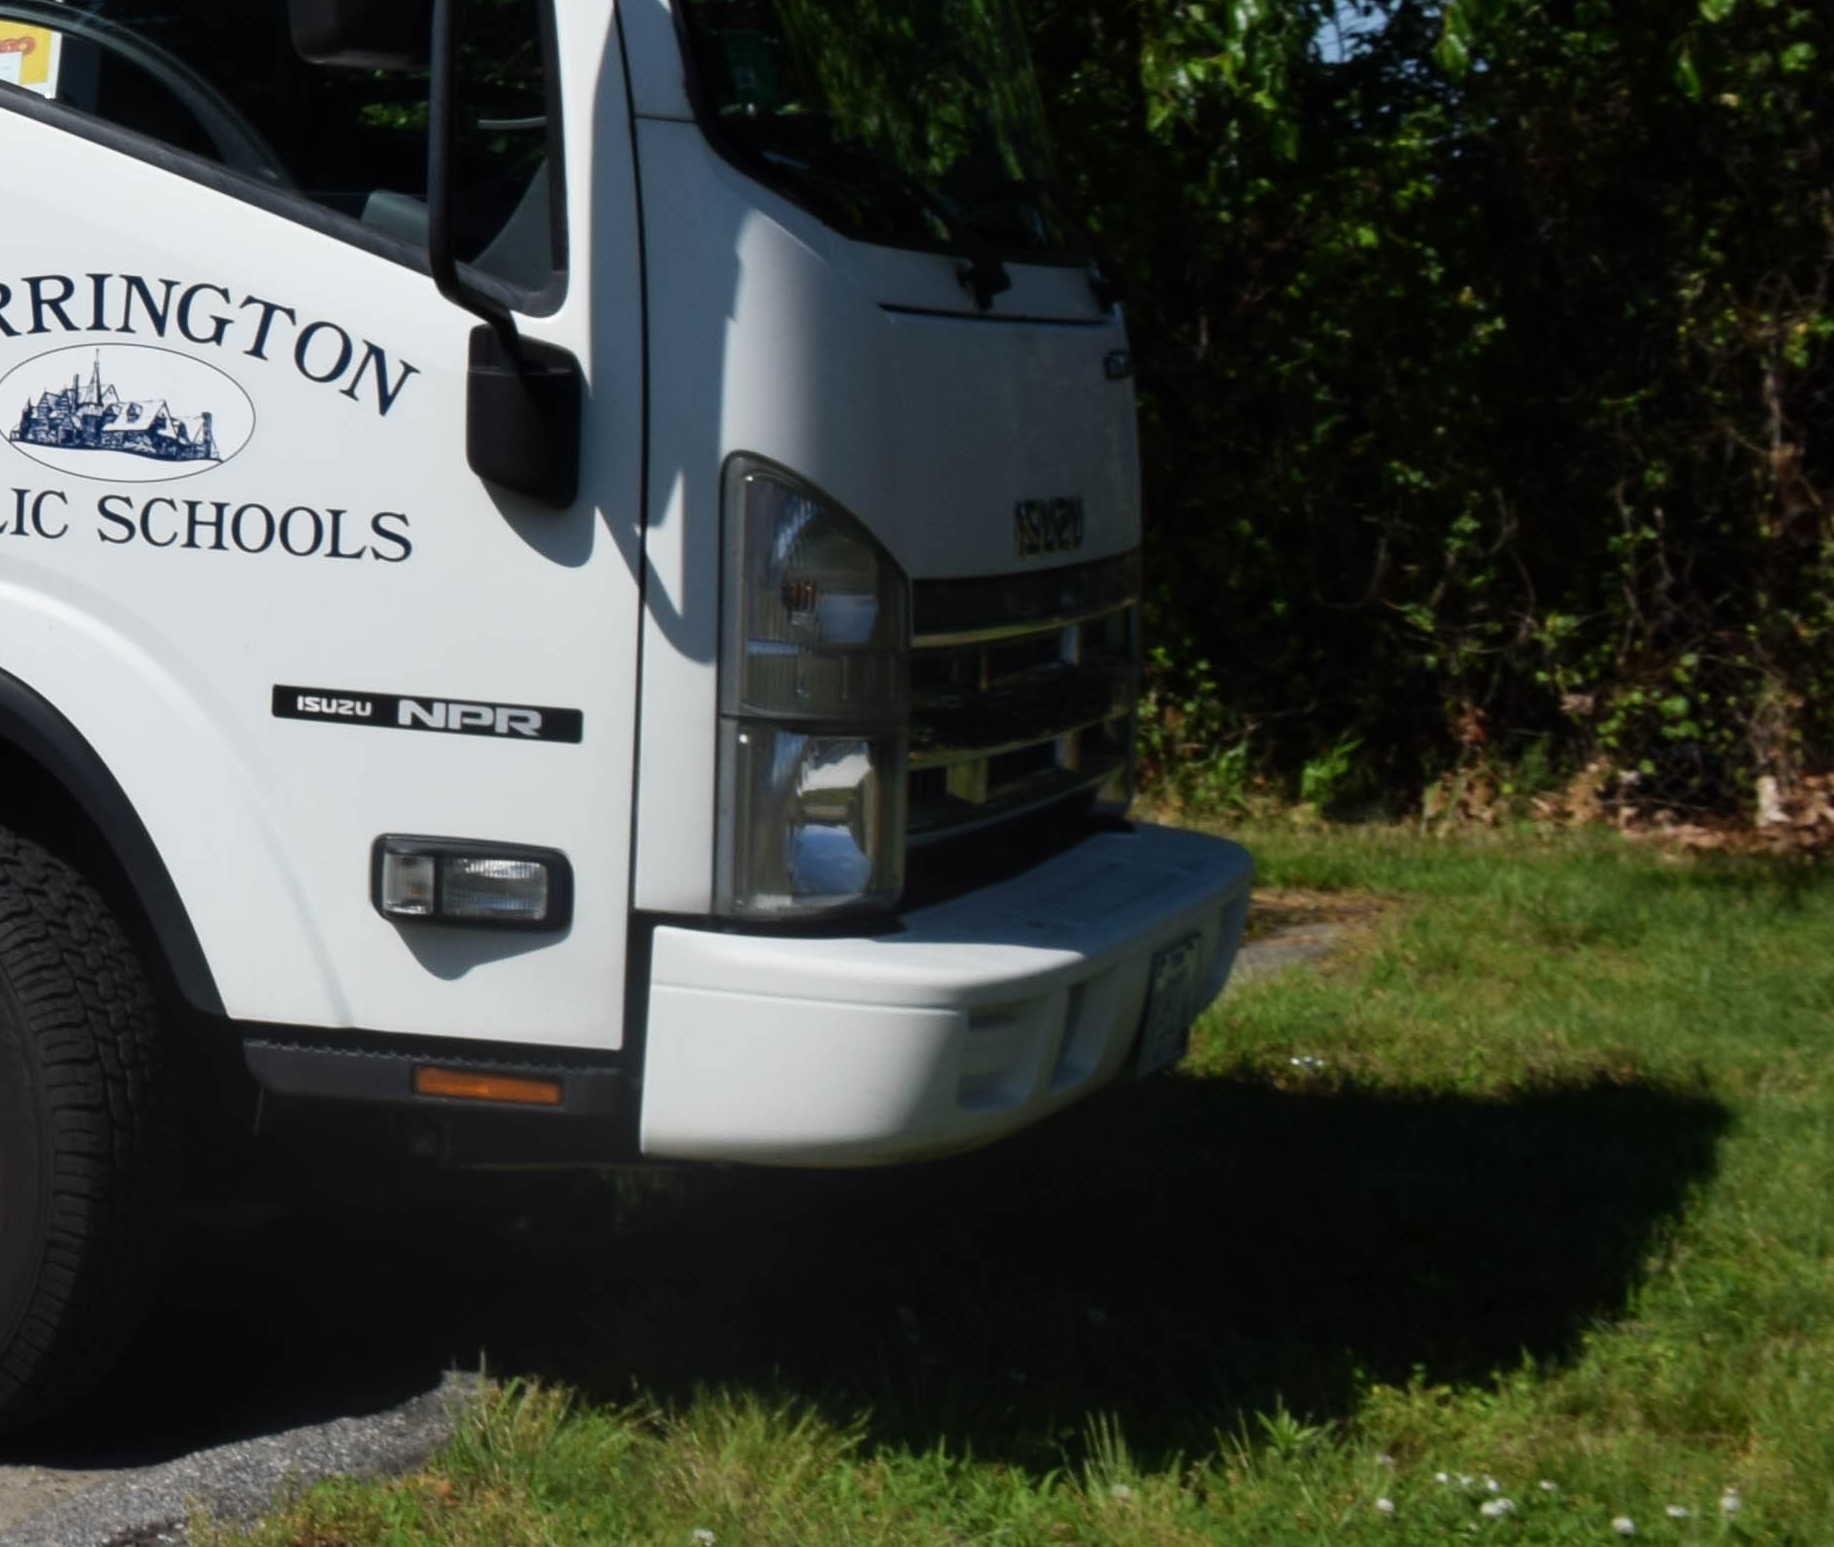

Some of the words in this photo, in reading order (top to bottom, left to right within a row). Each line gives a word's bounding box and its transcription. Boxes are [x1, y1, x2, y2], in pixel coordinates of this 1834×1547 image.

[97, 494, 413, 563] SCHOOLS
[297, 695, 372, 717] ISUZU
[397, 698, 543, 737] NPR
